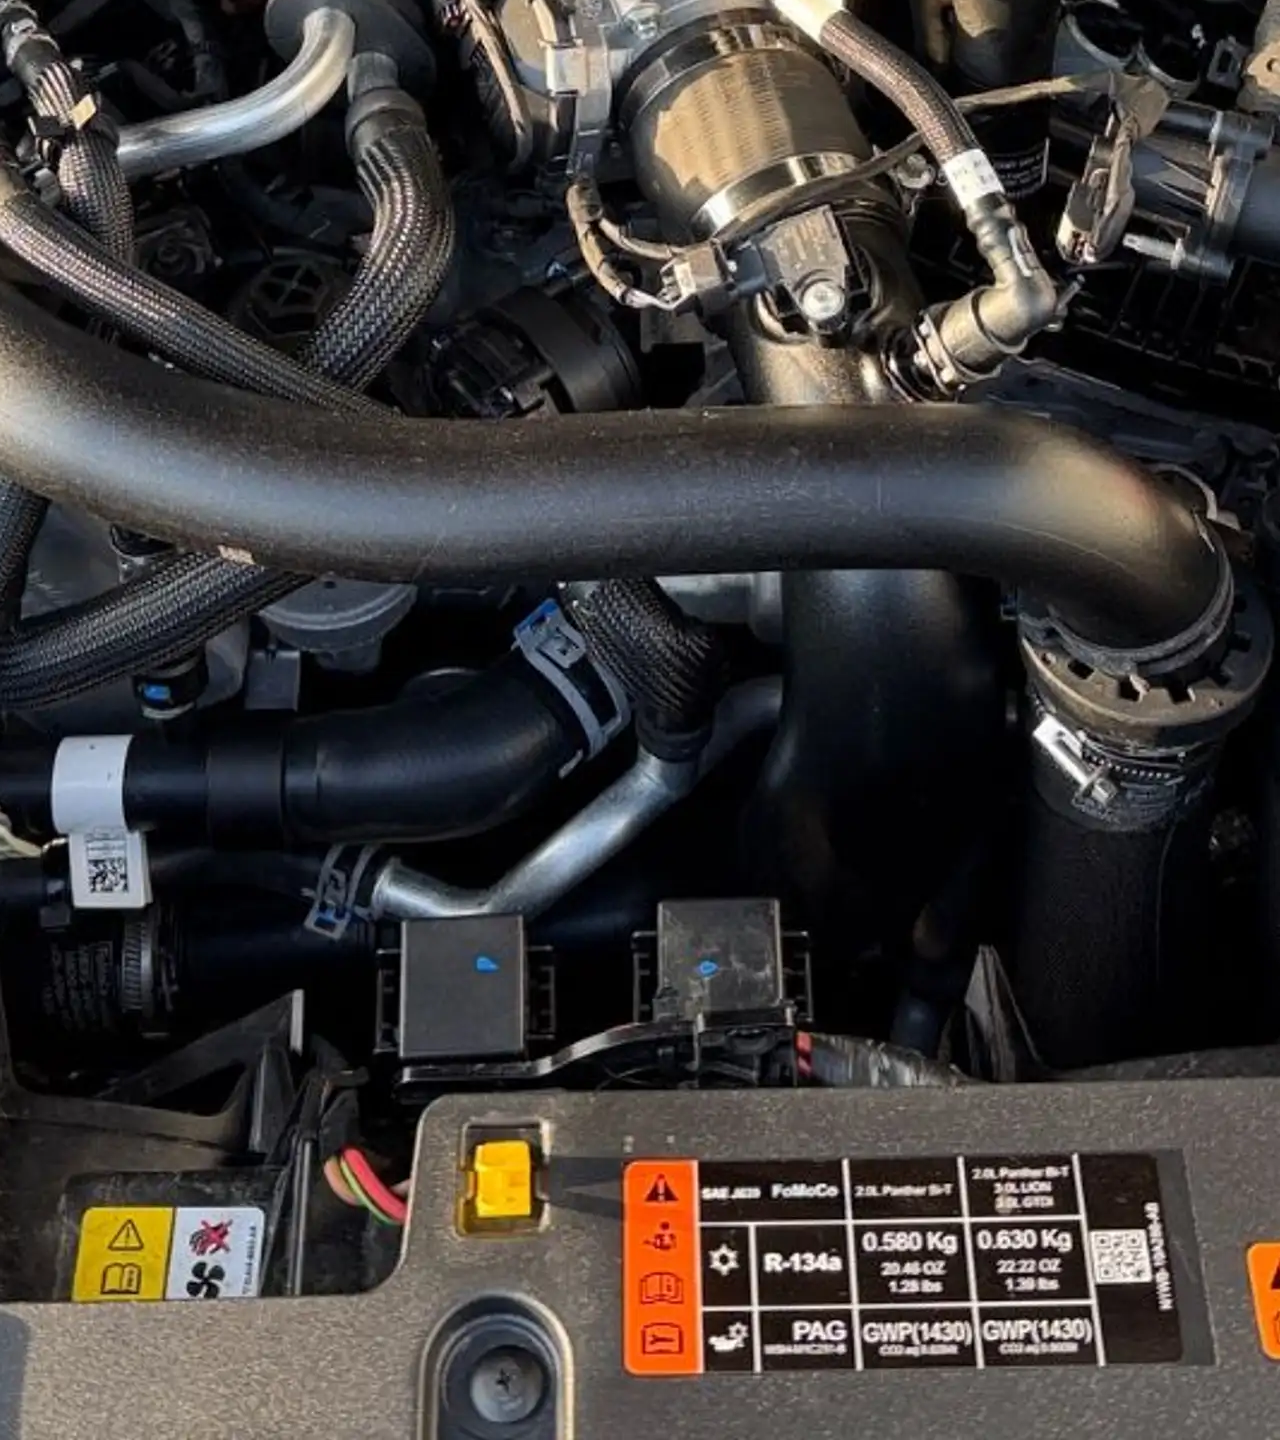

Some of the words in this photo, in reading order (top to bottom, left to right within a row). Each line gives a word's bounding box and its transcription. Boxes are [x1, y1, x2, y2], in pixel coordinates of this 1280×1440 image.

[771, 1184, 839, 1198] FoMoCo
[861, 1231, 922, 1252] 0.580
[926, 1231, 959, 1255] Kg
[976, 1230, 1037, 1250] 0.630
[1041, 1228, 1073, 1252] Kg
[763, 1252, 843, 1272] R-134a
[923, 1260, 947, 1275] OZ
[1038, 1258, 1062, 1273] OZ
[921, 1280, 943, 1293] lbs
[1037, 1277, 1060, 1290] lbs
[792, 1320, 848, 1341] PAG
[862, 1321, 972, 1346] GWP(1430)
[982, 1319, 1093, 1345] GWP(1430)
